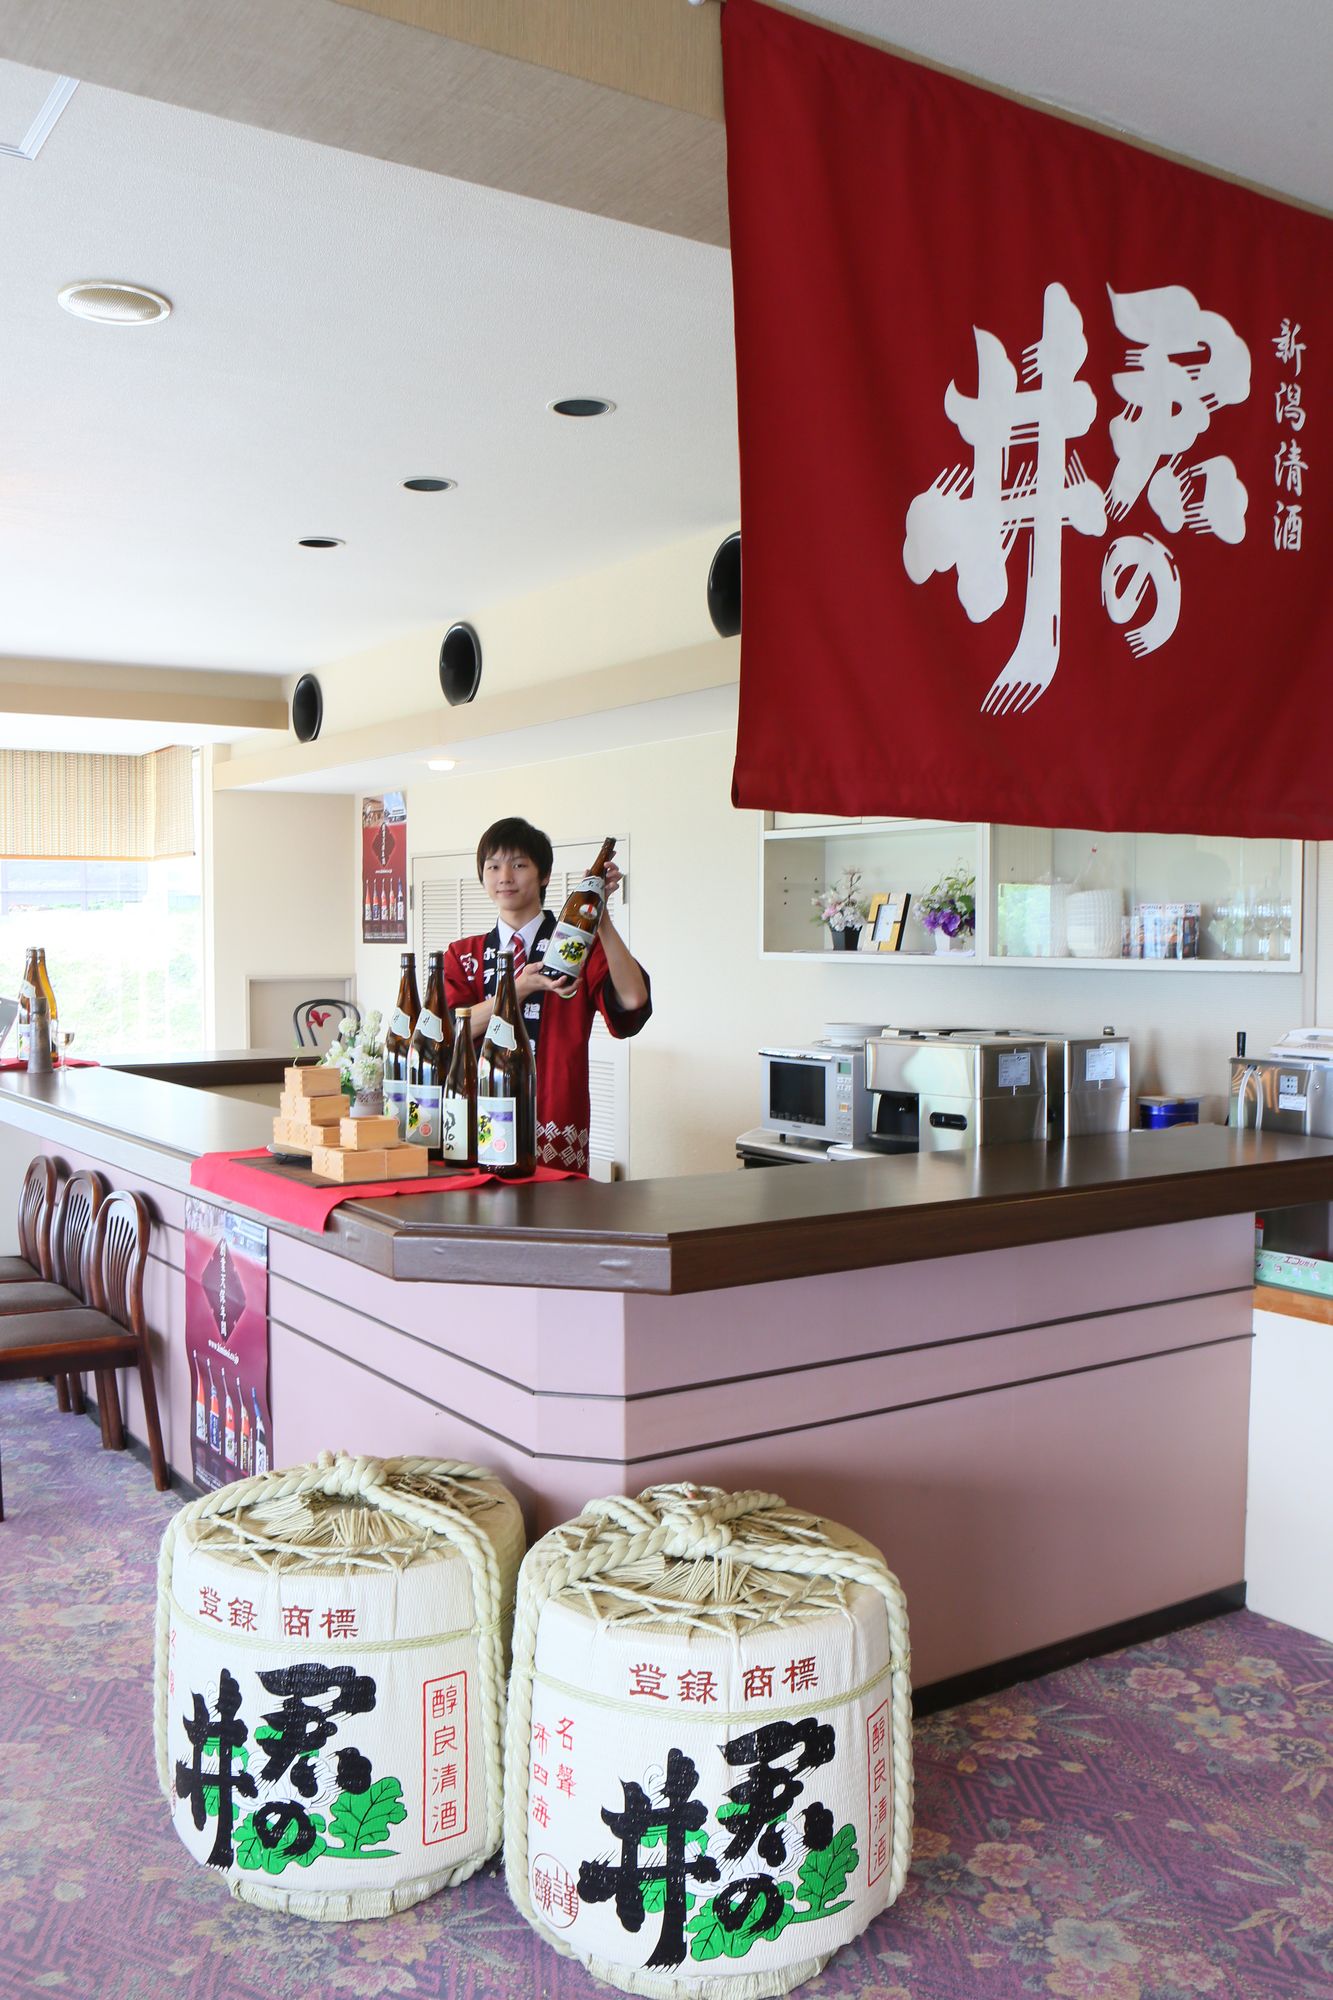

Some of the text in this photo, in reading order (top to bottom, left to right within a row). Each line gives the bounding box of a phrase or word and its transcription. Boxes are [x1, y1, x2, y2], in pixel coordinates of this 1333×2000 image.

[1271, 318, 1309, 552] 新潟清酒
[431, 1682, 458, 1835] 醇良清酒
[872, 1716, 887, 1872] 醇良清酒
